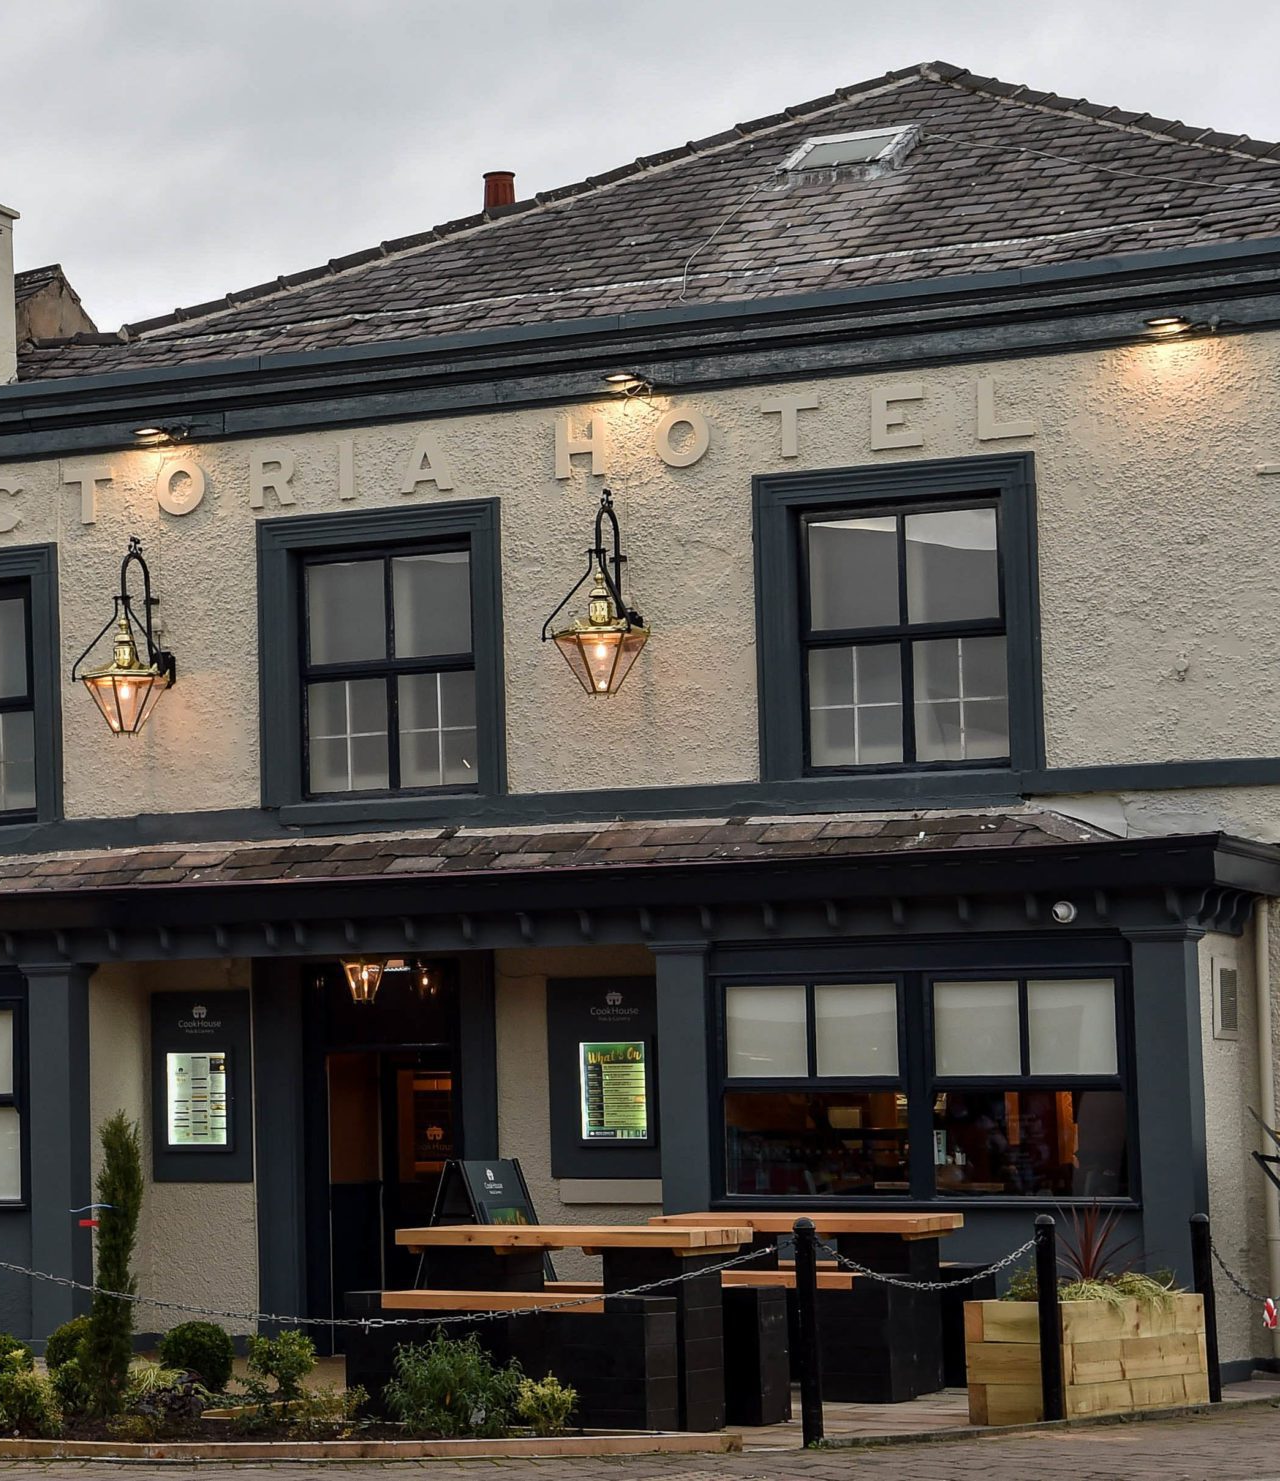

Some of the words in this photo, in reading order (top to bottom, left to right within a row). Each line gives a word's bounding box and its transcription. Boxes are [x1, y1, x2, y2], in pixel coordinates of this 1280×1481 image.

[553, 377, 1035, 480] HOTEL
[590, 1006, 640, 1016] CookHouse
[177, 1019, 222, 1028] CookHouse
[626, 1046, 642, 1061] On
